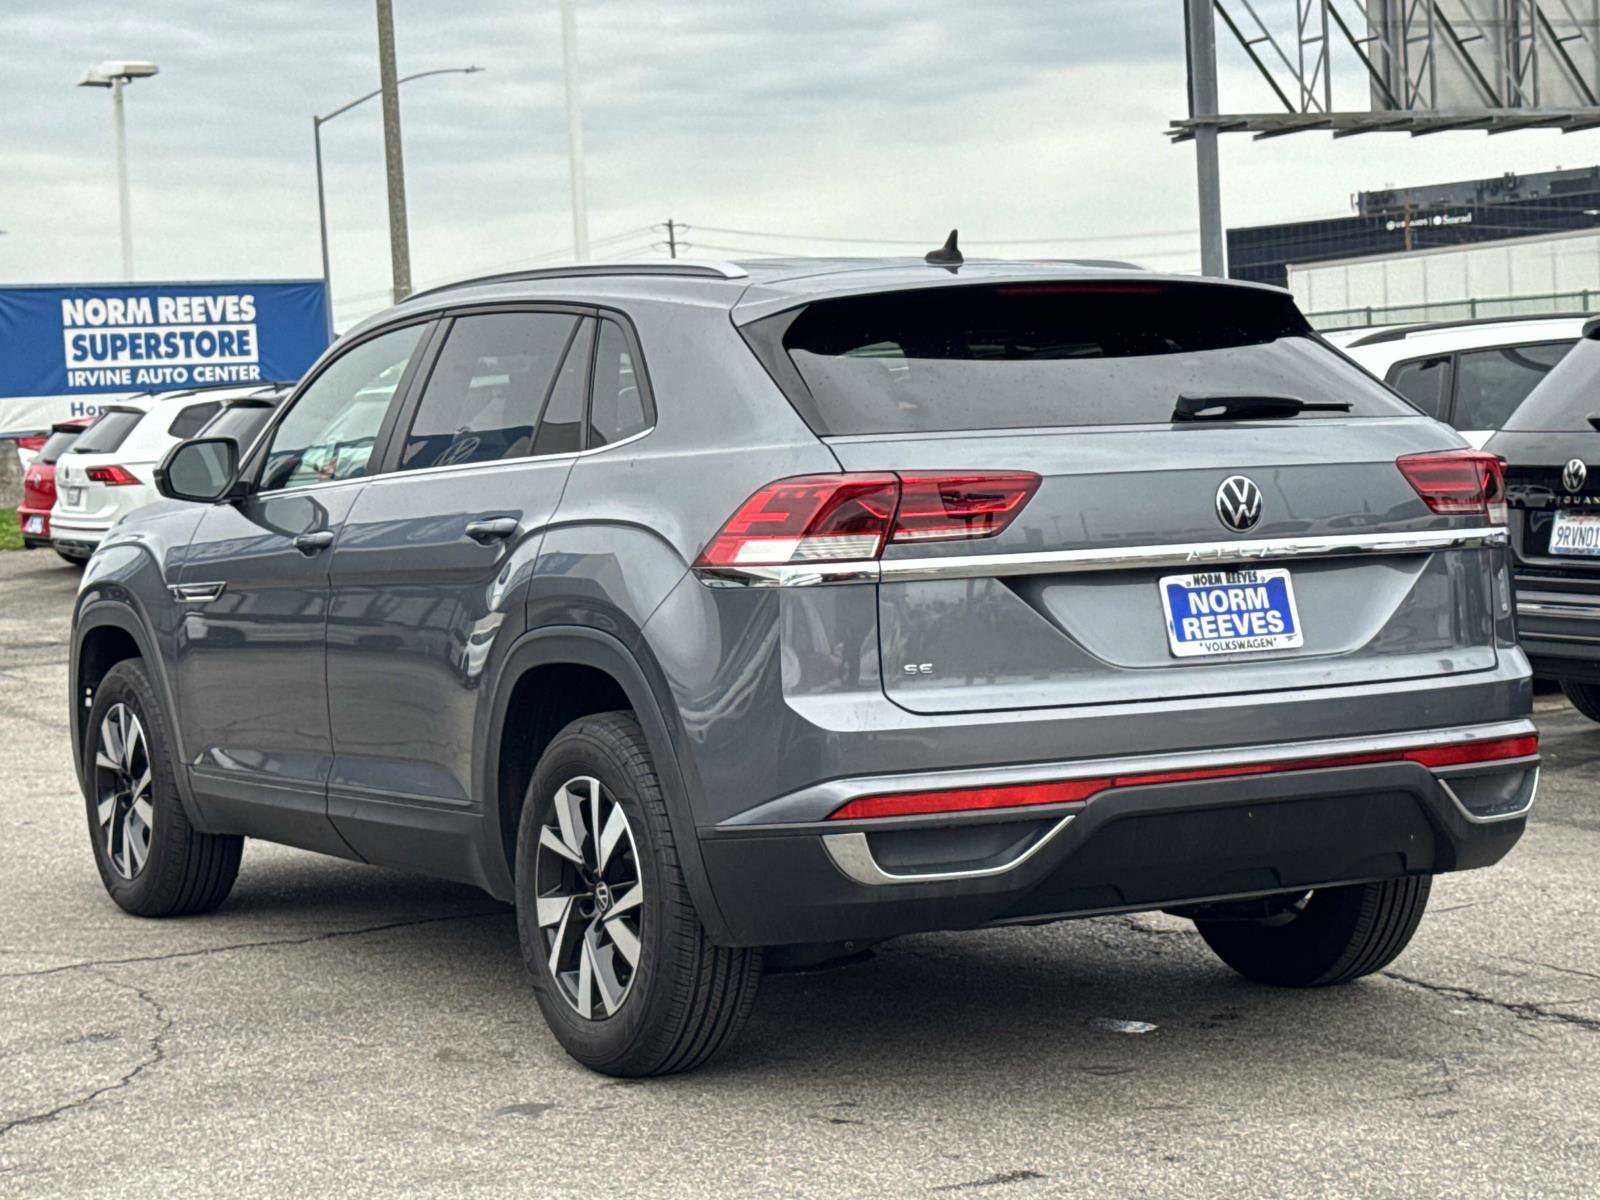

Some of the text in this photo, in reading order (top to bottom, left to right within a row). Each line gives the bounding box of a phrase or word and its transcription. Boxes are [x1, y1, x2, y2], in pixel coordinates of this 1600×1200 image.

[61, 295, 256, 326] NORM REEVES
[71, 329, 251, 362] SUPERSTORE
[67, 365, 261, 387] IRVINE AUTO CENTER
[1193, 571, 1258, 586] NORM REEVES
[1187, 586, 1270, 615] NORM
[1182, 610, 1285, 640] REEVES
[1205, 638, 1273, 652] VOLKSWAGEN
[903, 663, 933, 675] SE
